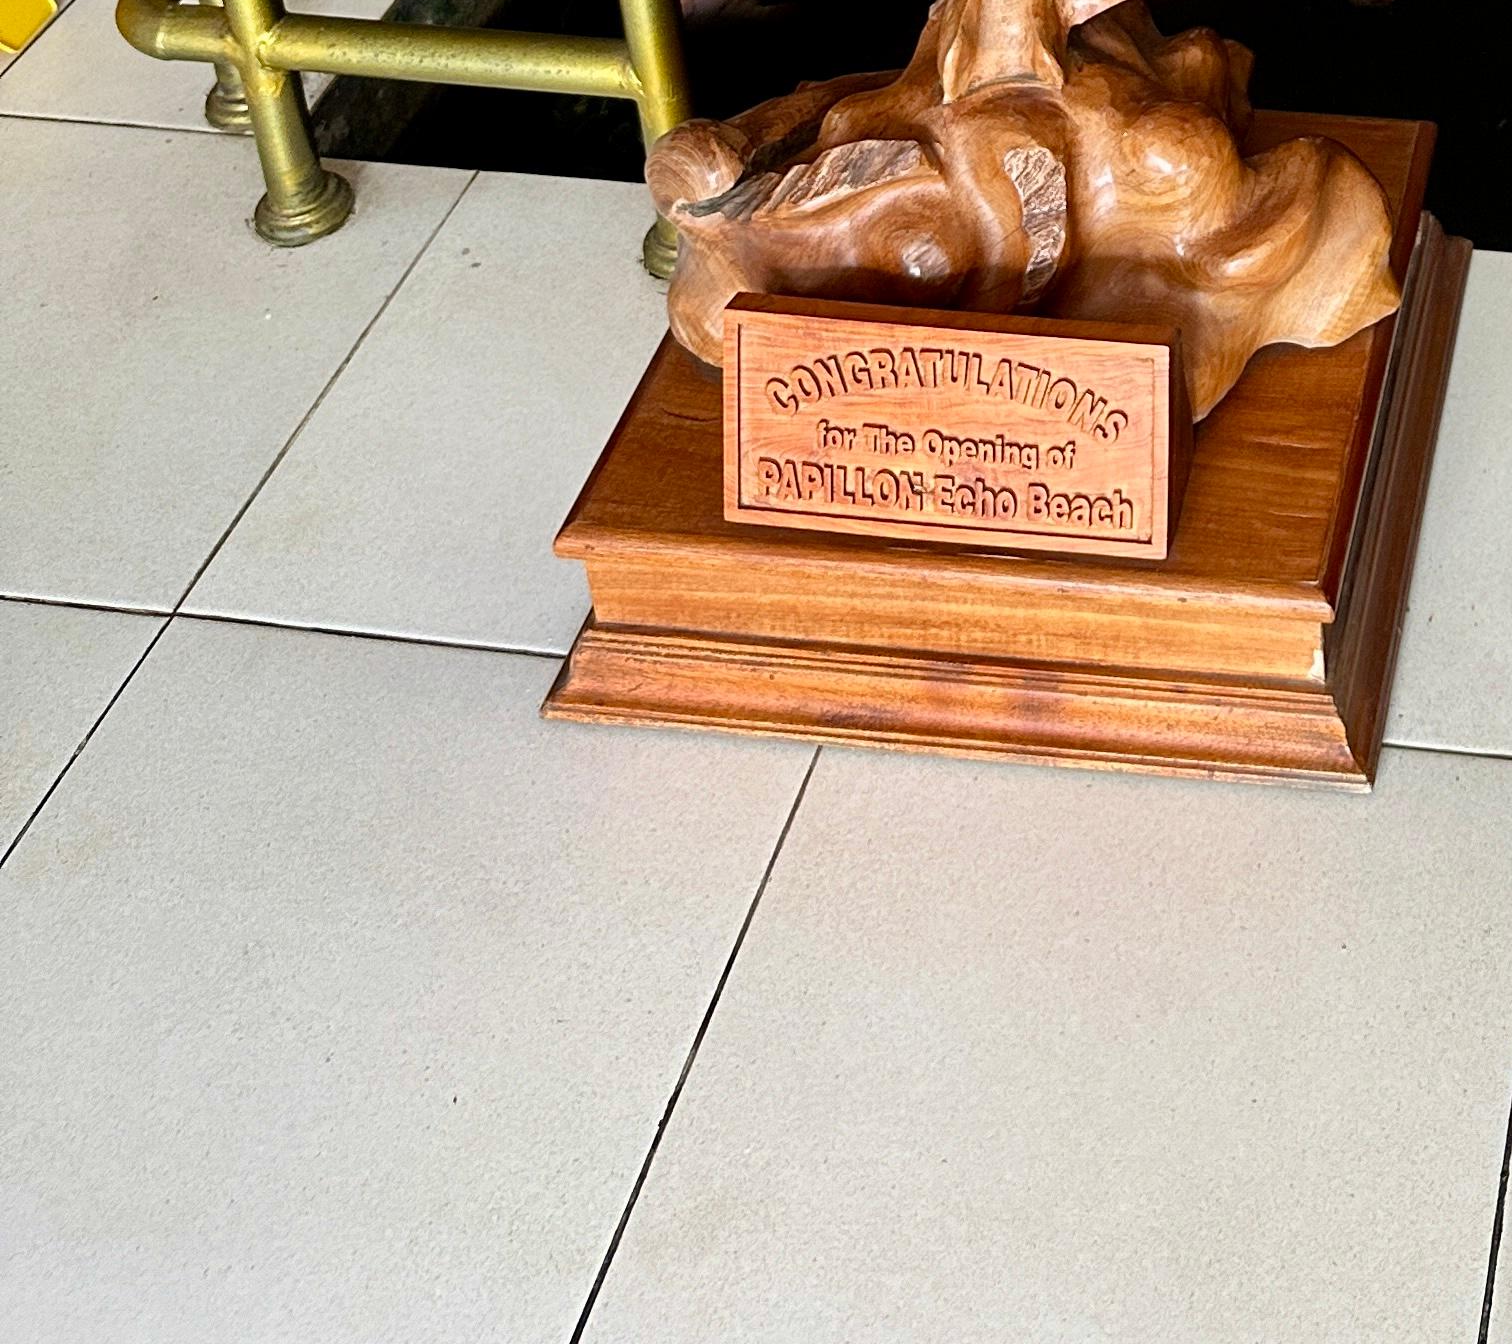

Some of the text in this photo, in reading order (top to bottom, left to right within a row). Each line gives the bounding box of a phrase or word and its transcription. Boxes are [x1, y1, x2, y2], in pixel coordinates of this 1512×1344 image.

[766, 347, 1129, 444] CONGRATULATIONS
[816, 418, 1077, 470] for The Opening of
[932, 473, 1018, 520] Echo
[1026, 481, 1134, 530] Beach
